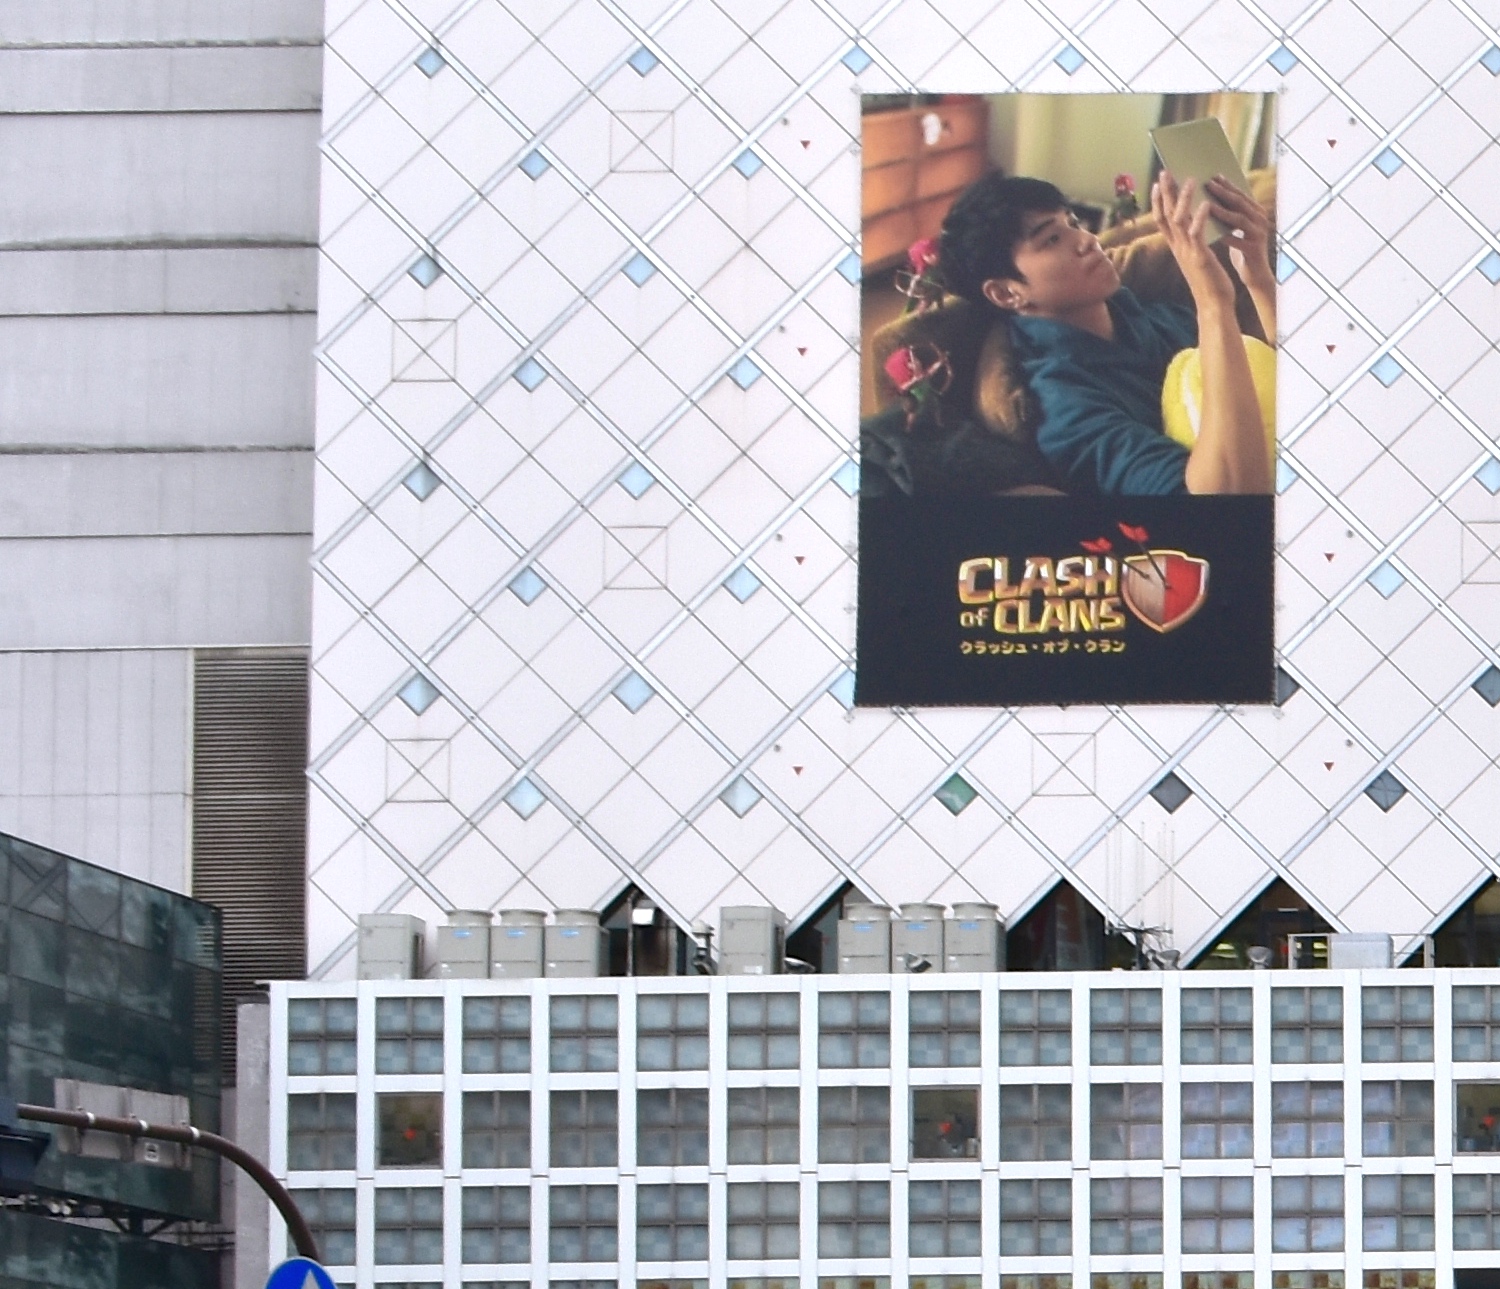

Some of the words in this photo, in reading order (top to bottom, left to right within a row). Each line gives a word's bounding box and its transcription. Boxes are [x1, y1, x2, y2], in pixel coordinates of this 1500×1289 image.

[957, 556, 1120, 603] CLASH
[960, 606, 989, 628] of
[994, 598, 1125, 633] CLANS
[960, 638, 1126, 655] クラッシュ・オブ・クラン
